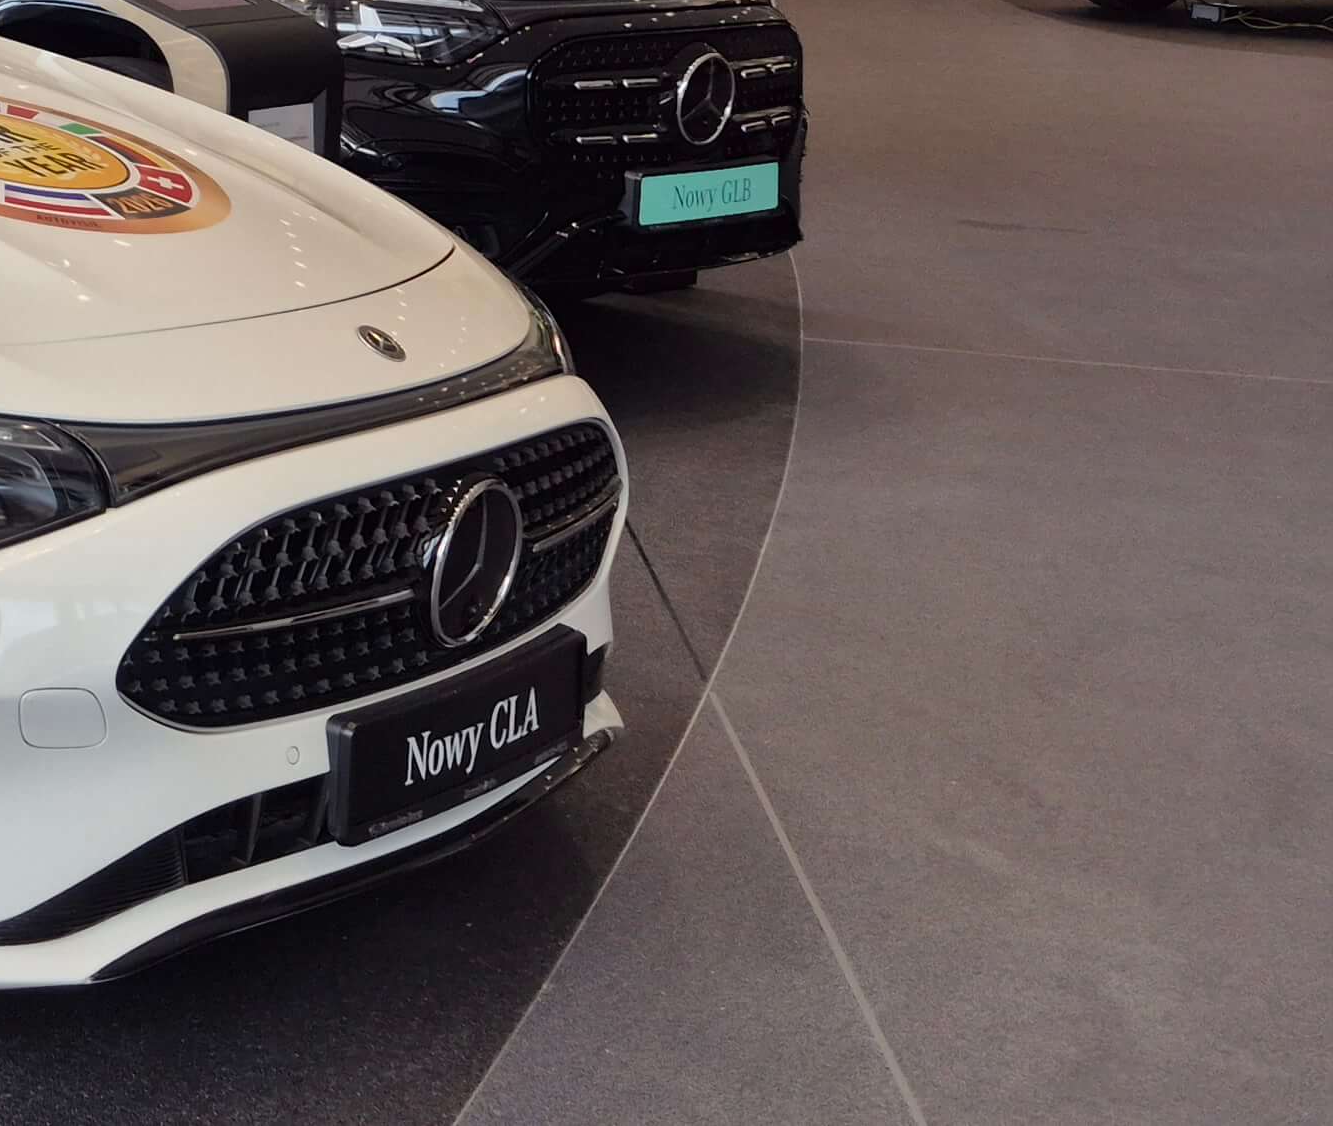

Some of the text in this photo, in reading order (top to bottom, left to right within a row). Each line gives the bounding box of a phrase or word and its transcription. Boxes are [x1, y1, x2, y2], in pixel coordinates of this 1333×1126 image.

[11, 141, 61, 153] THE
[2, 152, 106, 177] YEAR
[672, 177, 752, 212] Nowy GLB
[404, 686, 540, 786] Nowy CLA
